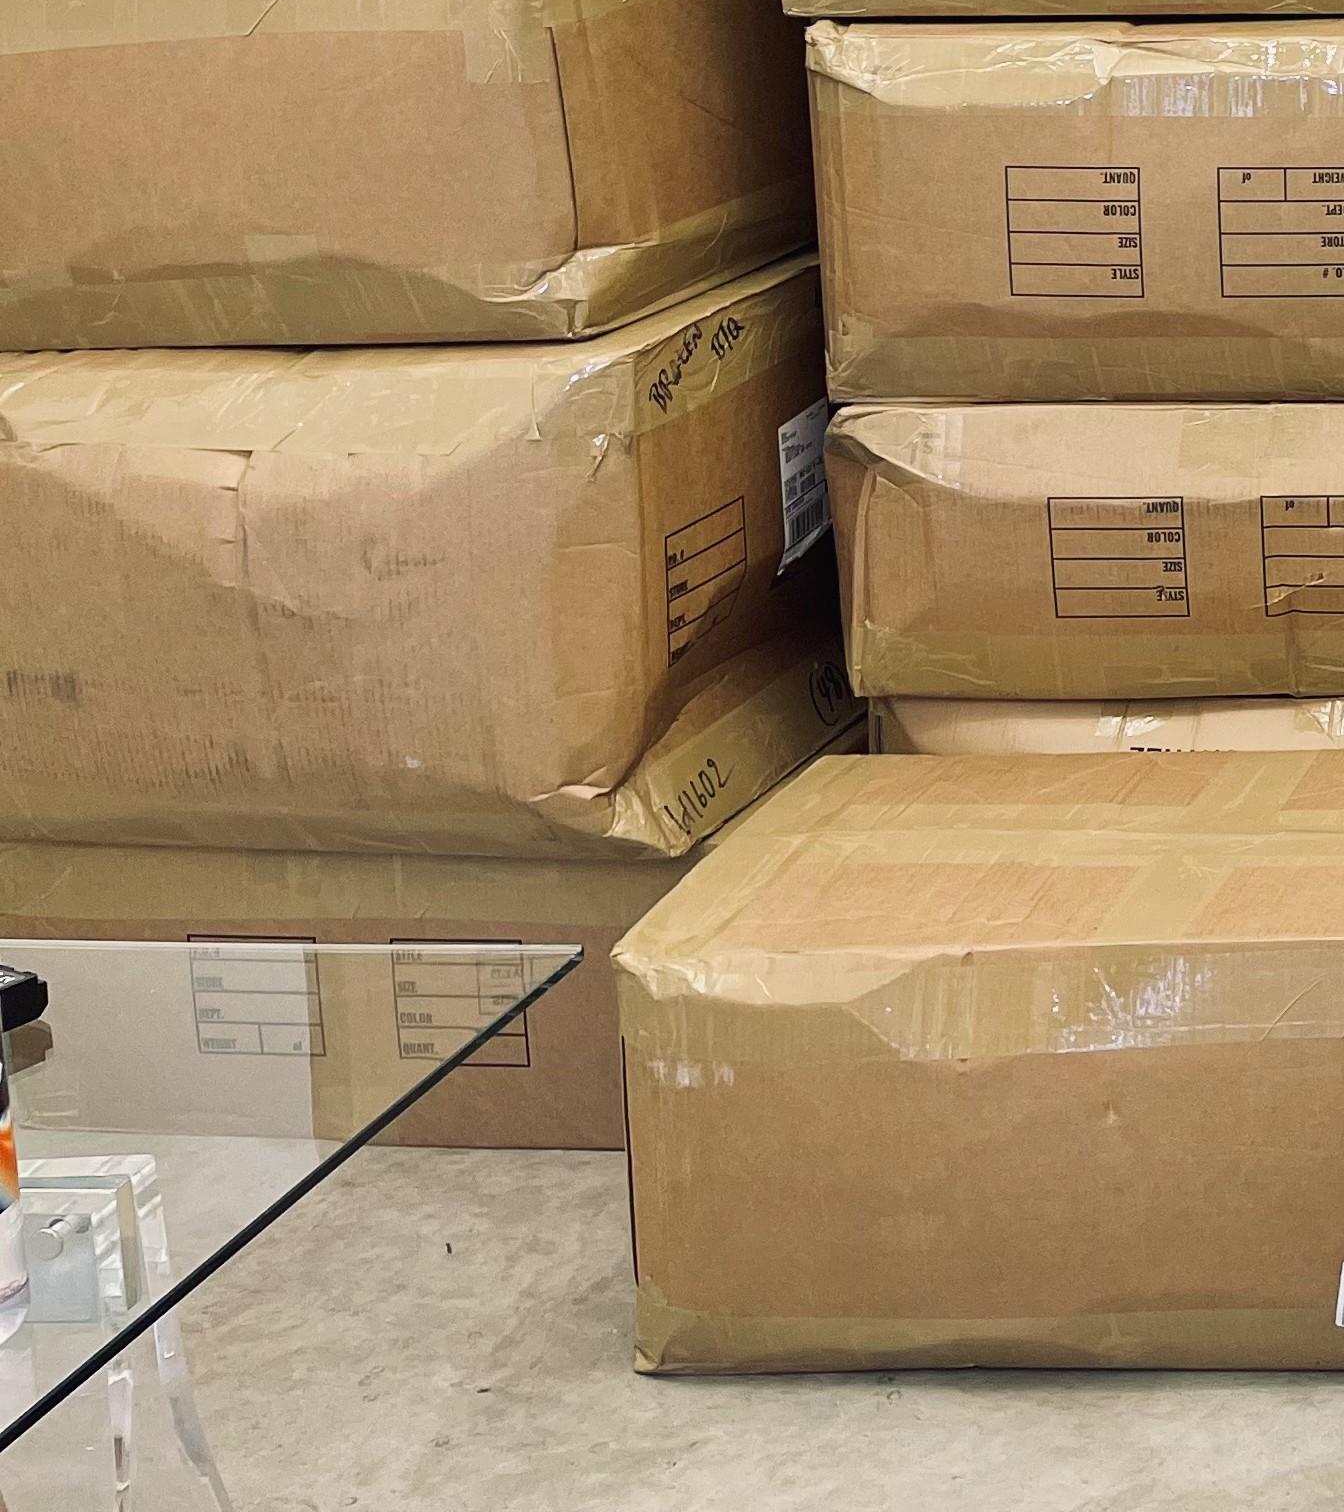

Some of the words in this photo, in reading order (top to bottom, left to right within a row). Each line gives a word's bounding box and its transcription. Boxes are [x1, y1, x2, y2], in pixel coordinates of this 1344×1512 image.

[1100, 172, 1136, 184] QUANT.
[1103, 204, 1136, 216] COLOR
[1117, 237, 1138, 248] SIZE
[1111, 268, 1140, 280] STYLE
[1143, 501, 1179, 513] QUANT.
[1146, 532, 1181, 543] COLOR
[1162, 561, 1183, 572] SIZE
